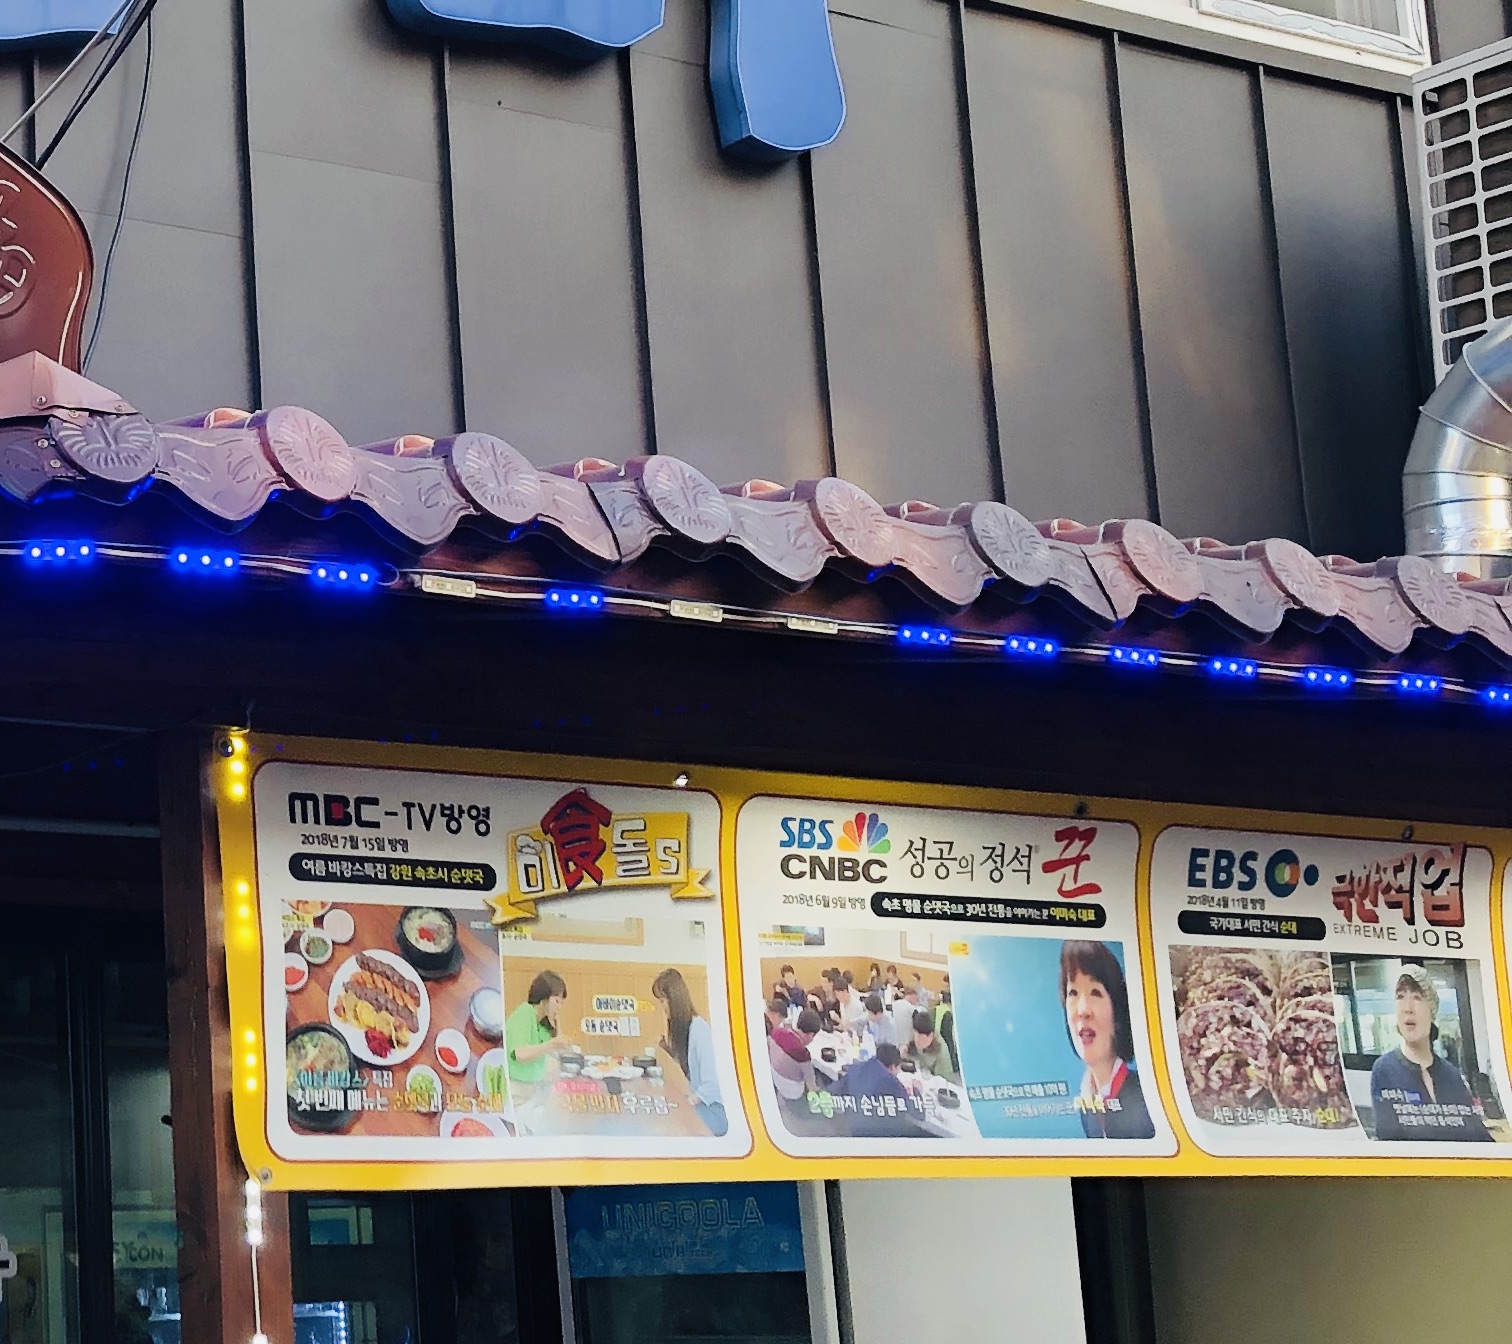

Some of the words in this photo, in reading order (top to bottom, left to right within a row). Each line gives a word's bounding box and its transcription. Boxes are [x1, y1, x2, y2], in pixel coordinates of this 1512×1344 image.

[301, 833, 338, 848] 2018년
[362, 837, 385, 852] 15일
[779, 816, 834, 850] SBS
[779, 853, 888, 884] CNBC
[899, 836, 975, 882] 성공의
[980, 842, 1033, 885] 정석
[1042, 826, 1102, 898] 꾼
[1187, 847, 1259, 891] EBS
[782, 893, 814, 907] 2018년
[815, 894, 830, 908] 6월
[831, 896, 846, 909] 9일
[1262, 919, 1279, 933] 간식
[1333, 923, 1398, 941] EXTREME
[1409, 928, 1464, 949] JOB
